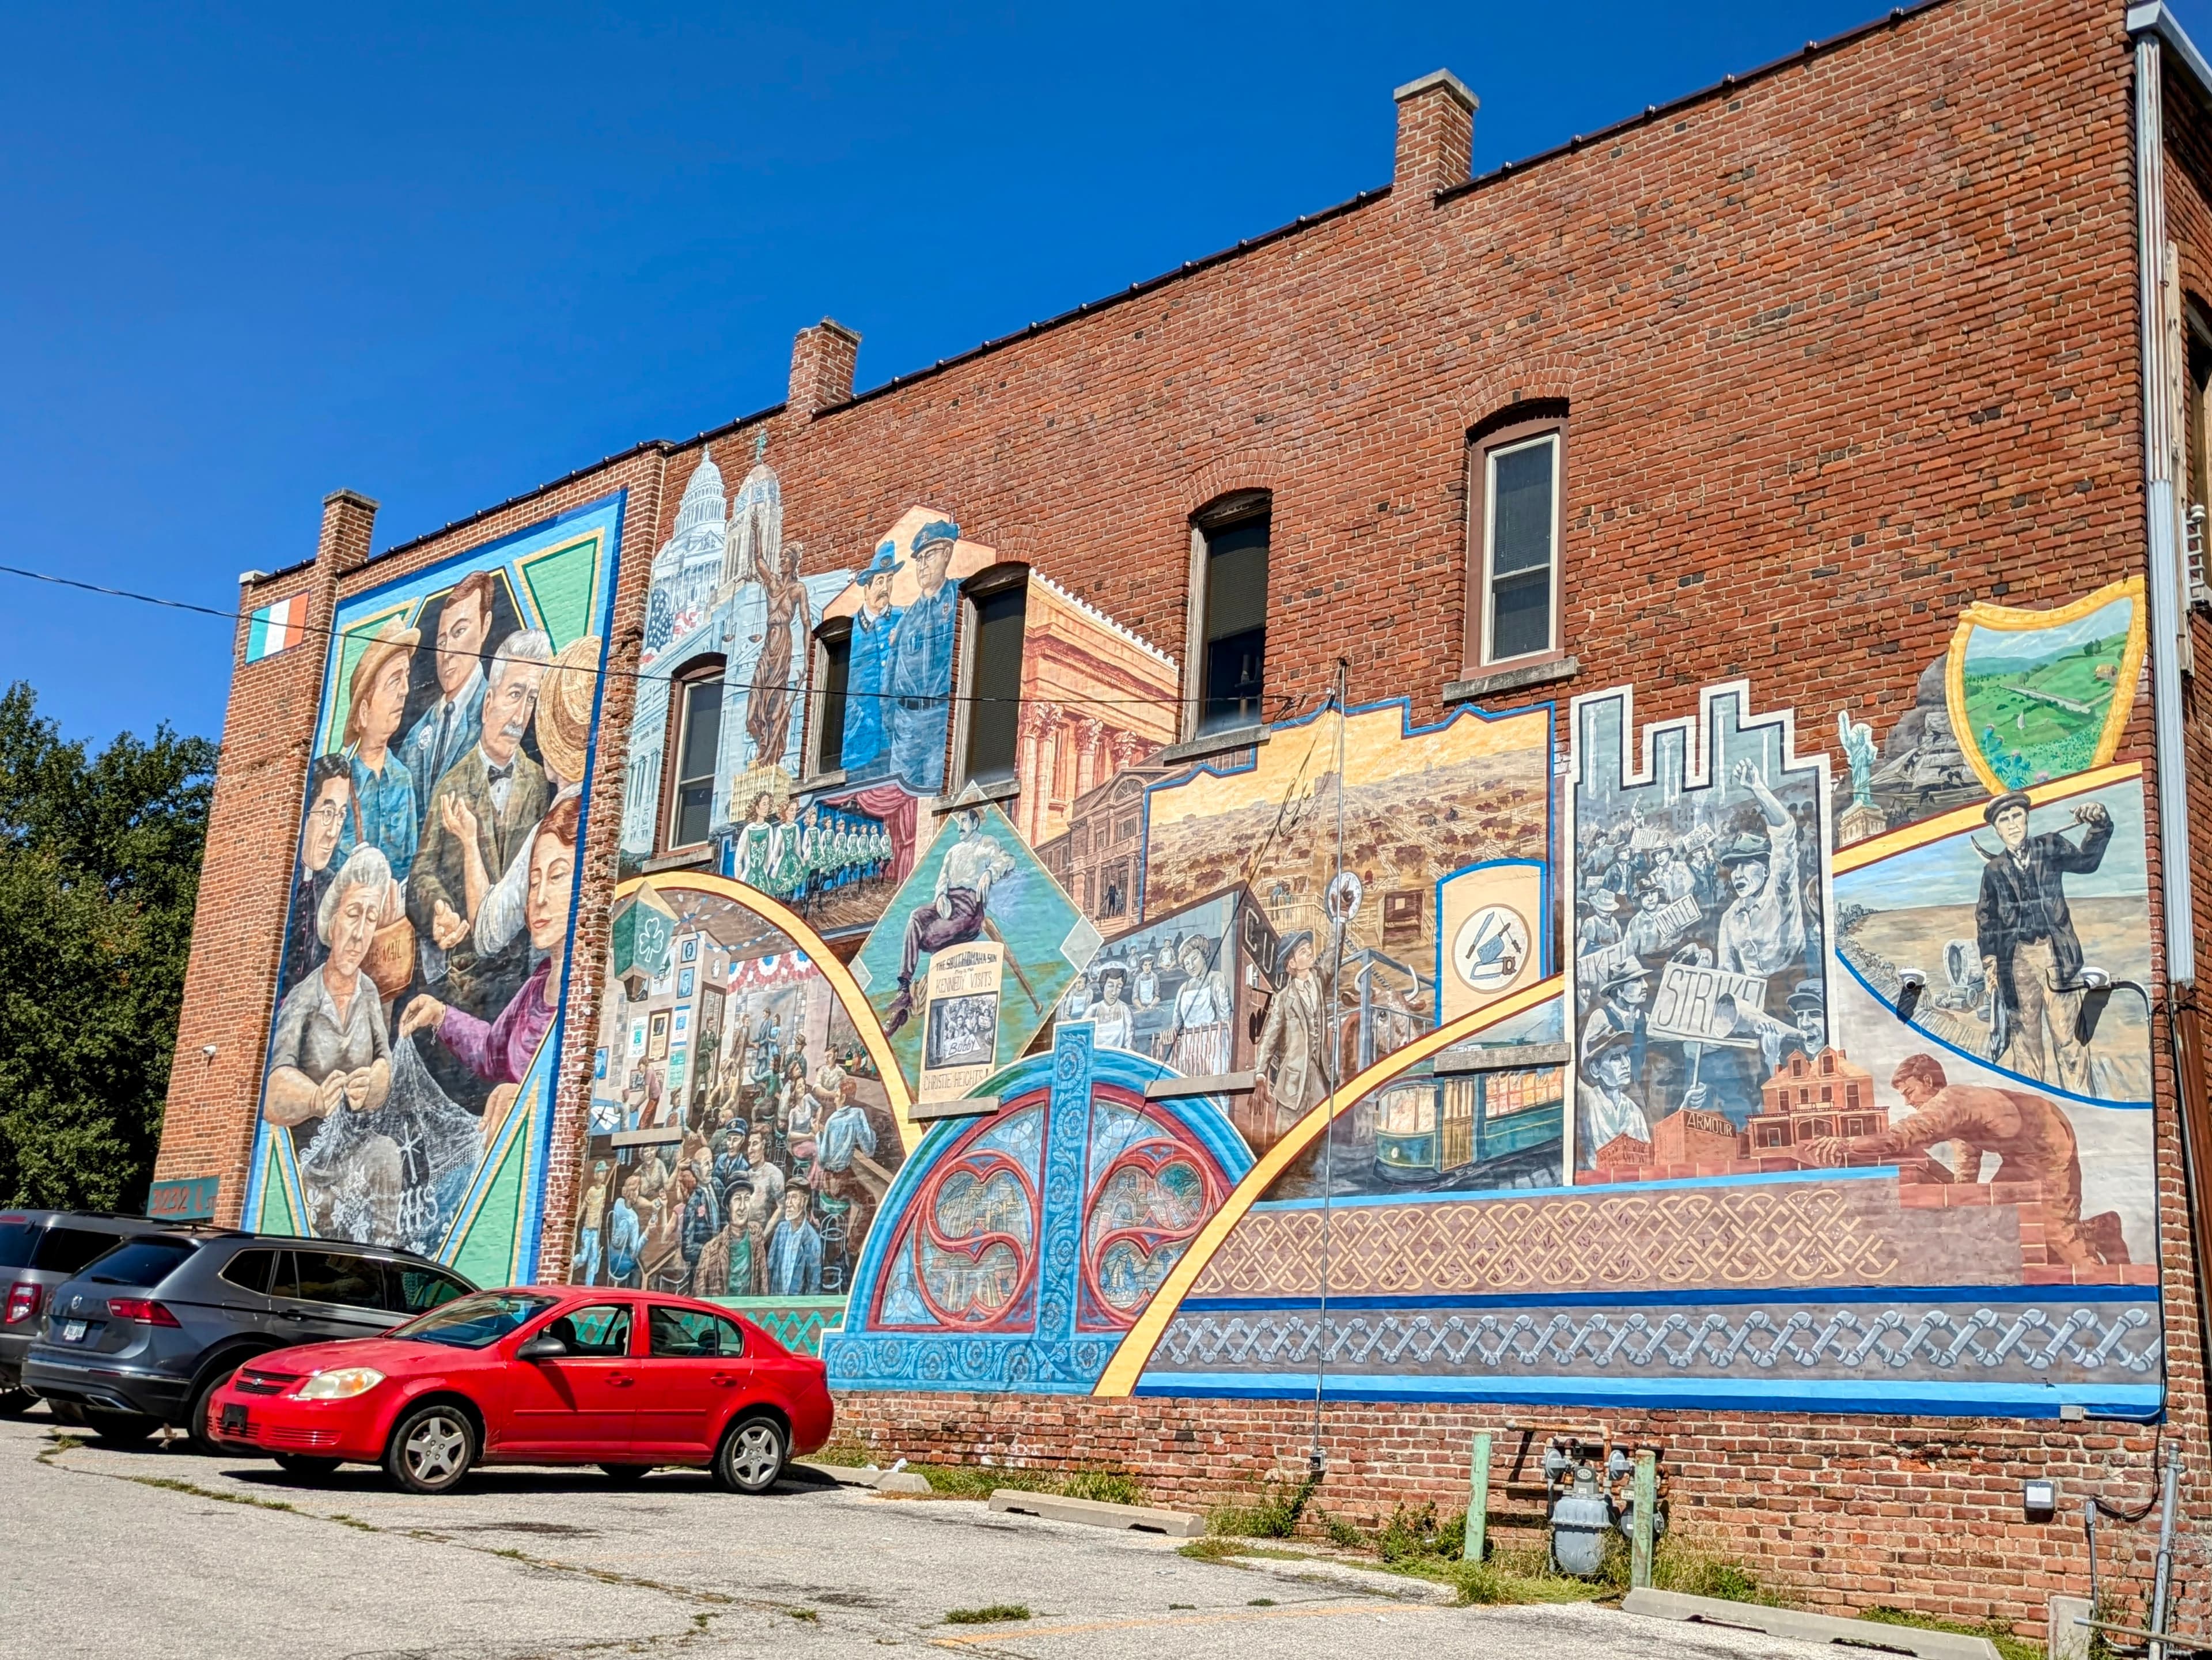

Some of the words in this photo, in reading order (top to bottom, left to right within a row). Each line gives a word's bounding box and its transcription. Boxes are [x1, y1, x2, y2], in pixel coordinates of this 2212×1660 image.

[1687, 829, 1713, 850] PACKERS
[1655, 895, 1699, 935] UNITE!
[382, 939, 402, 963] MAIL
[935, 959, 945, 972] THE
[967, 951, 987, 966] OMAHA
[935, 974, 966, 994] KENNEDY
[970, 970, 992, 988] VISITS
[948, 1036, 976, 1055] Bobby
[923, 1073, 952, 1091] CHRISTIE
[1687, 1112, 1733, 1137] ARMOUR
[150, 1186, 190, 1215] 3232
